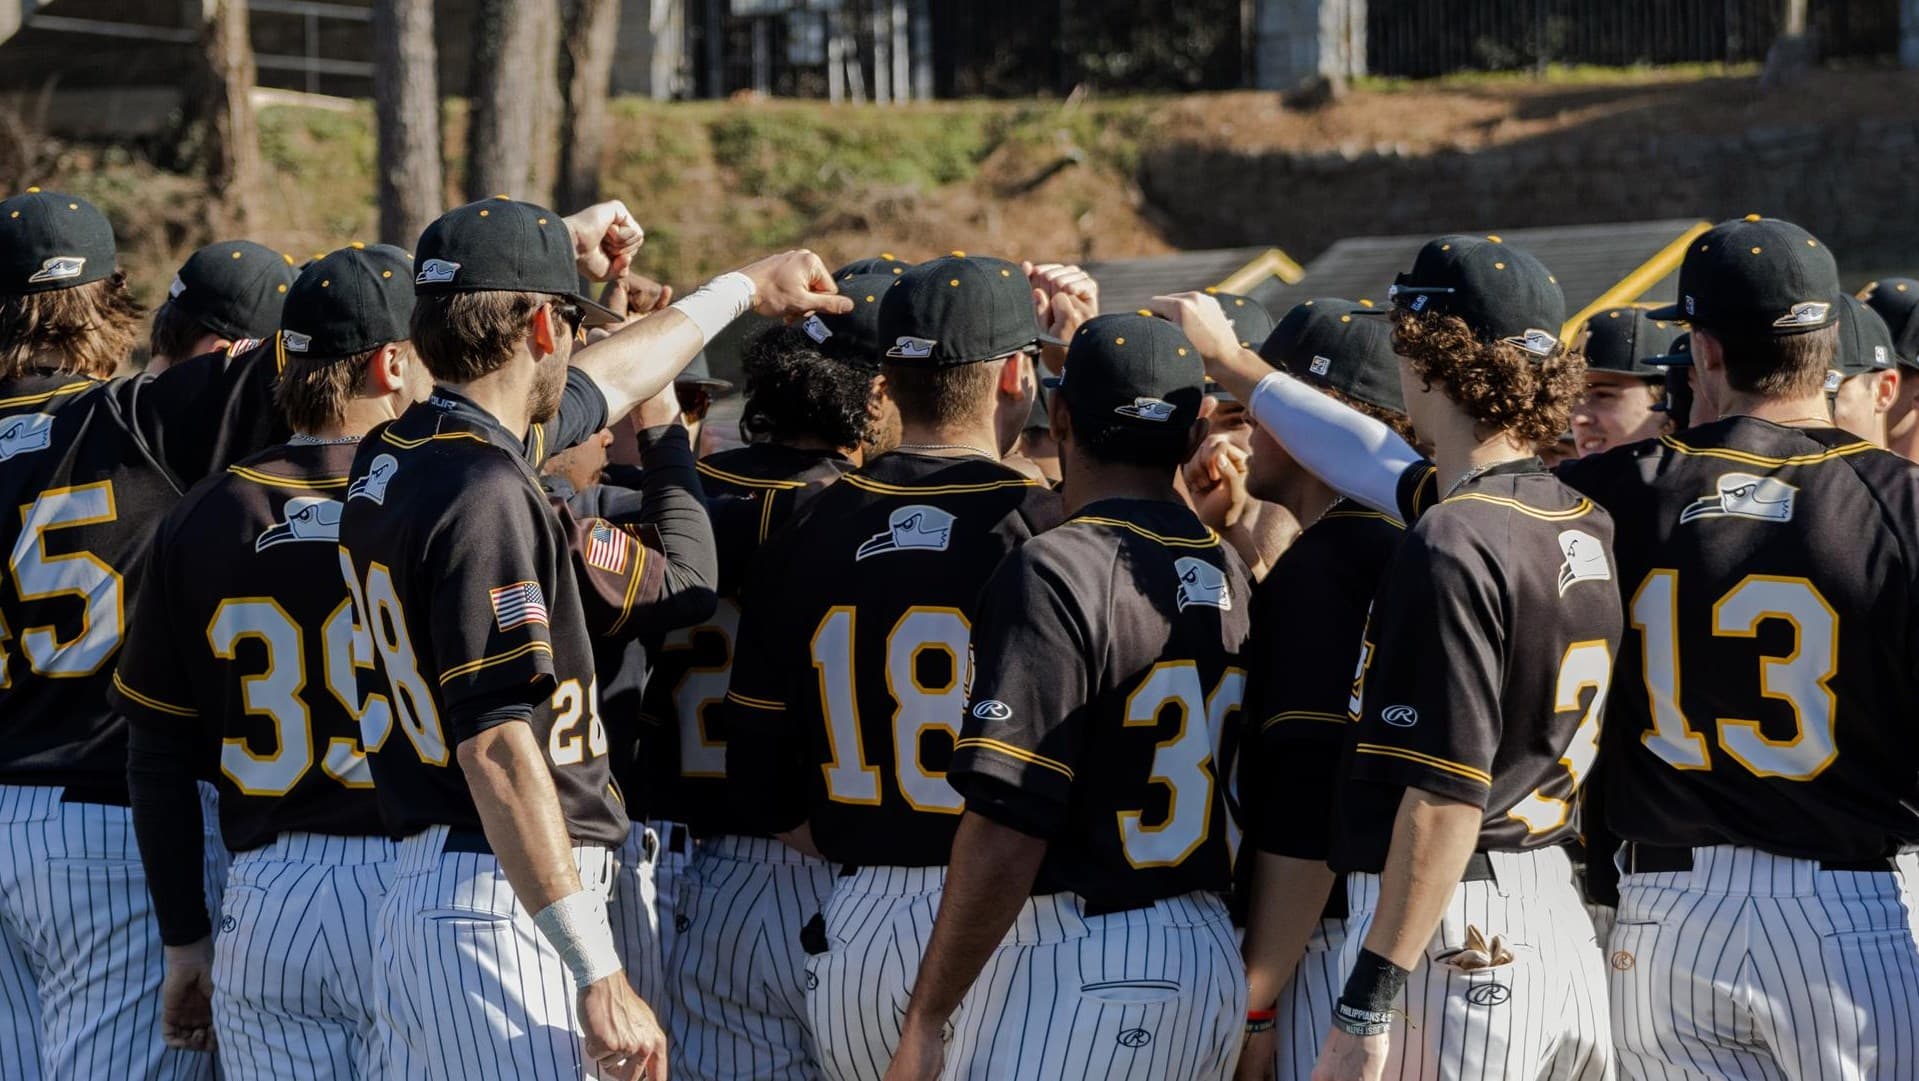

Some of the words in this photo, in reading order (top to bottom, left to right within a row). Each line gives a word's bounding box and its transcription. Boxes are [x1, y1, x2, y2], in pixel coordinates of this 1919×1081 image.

[0, 479, 125, 689] 5
[1629, 568, 1839, 782] 13
[809, 605, 972, 815] 18
[1340, 1004, 1380, 1022] PHILIPPIANS
